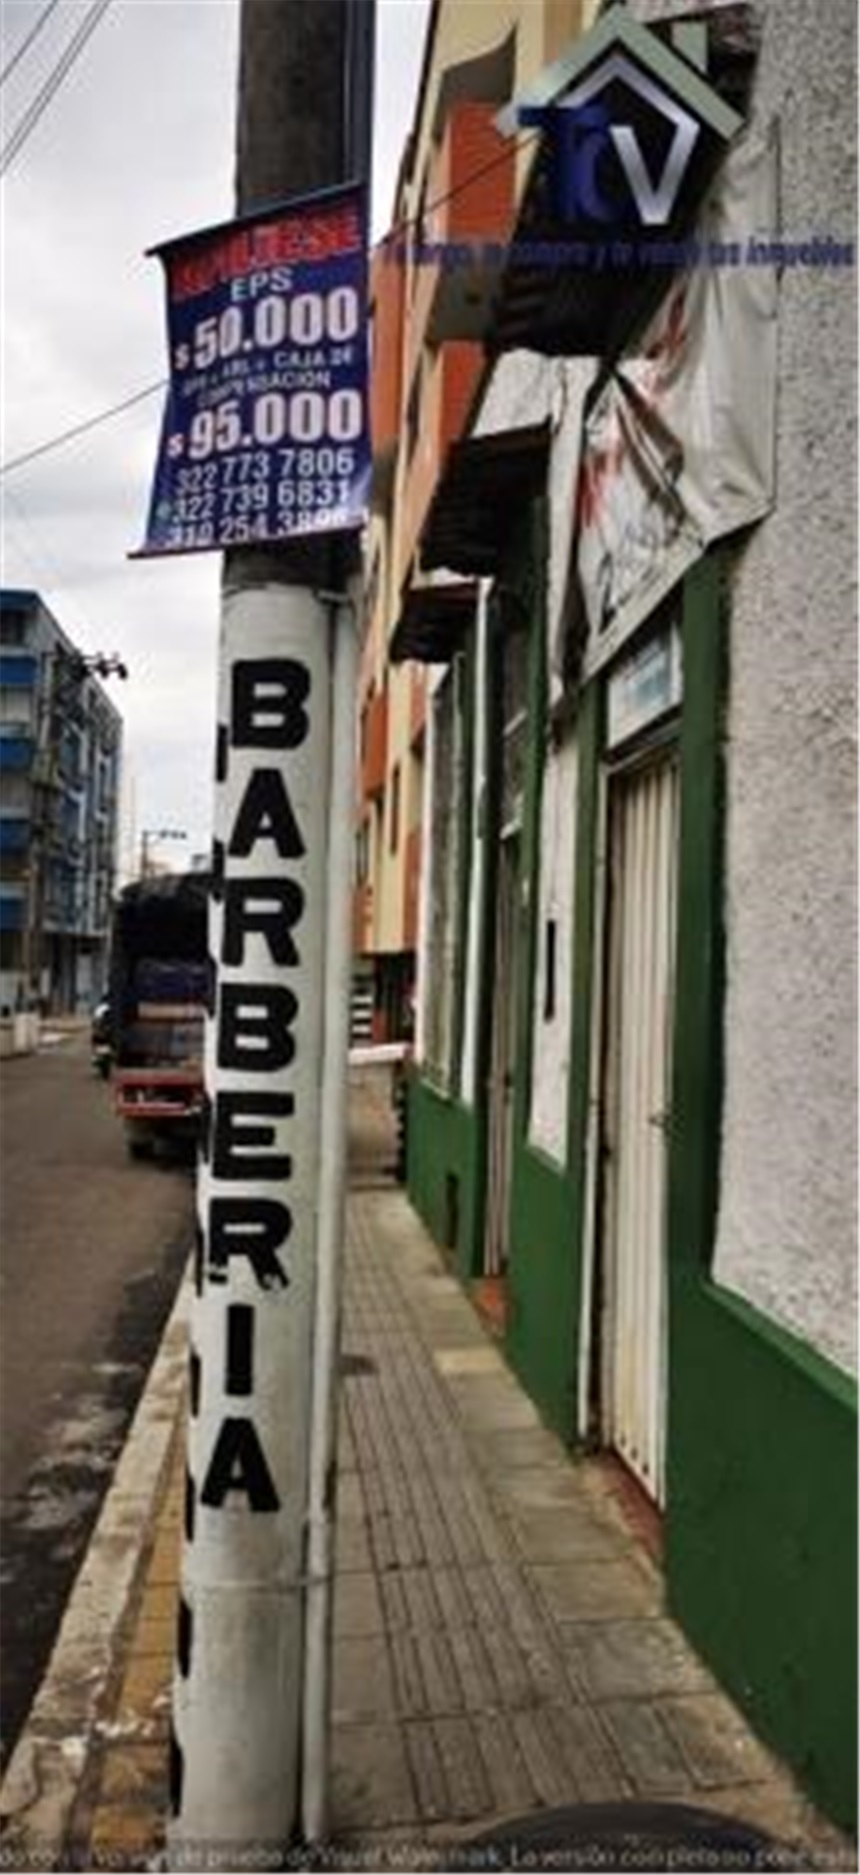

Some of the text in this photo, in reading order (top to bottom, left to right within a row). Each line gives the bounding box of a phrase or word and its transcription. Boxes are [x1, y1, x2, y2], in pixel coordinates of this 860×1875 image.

[230, 266, 293, 302] EPS
[174, 286, 360, 371] $ 50.000
[273, 350, 326, 371] CAJA
[168, 388, 364, 461] $ 95.000
[174, 448, 356, 496] 322 773 7806
[221, 483, 270, 515] 739
[277, 478, 350, 508] 6831
[200, 658, 313, 1514] BARBERIA
